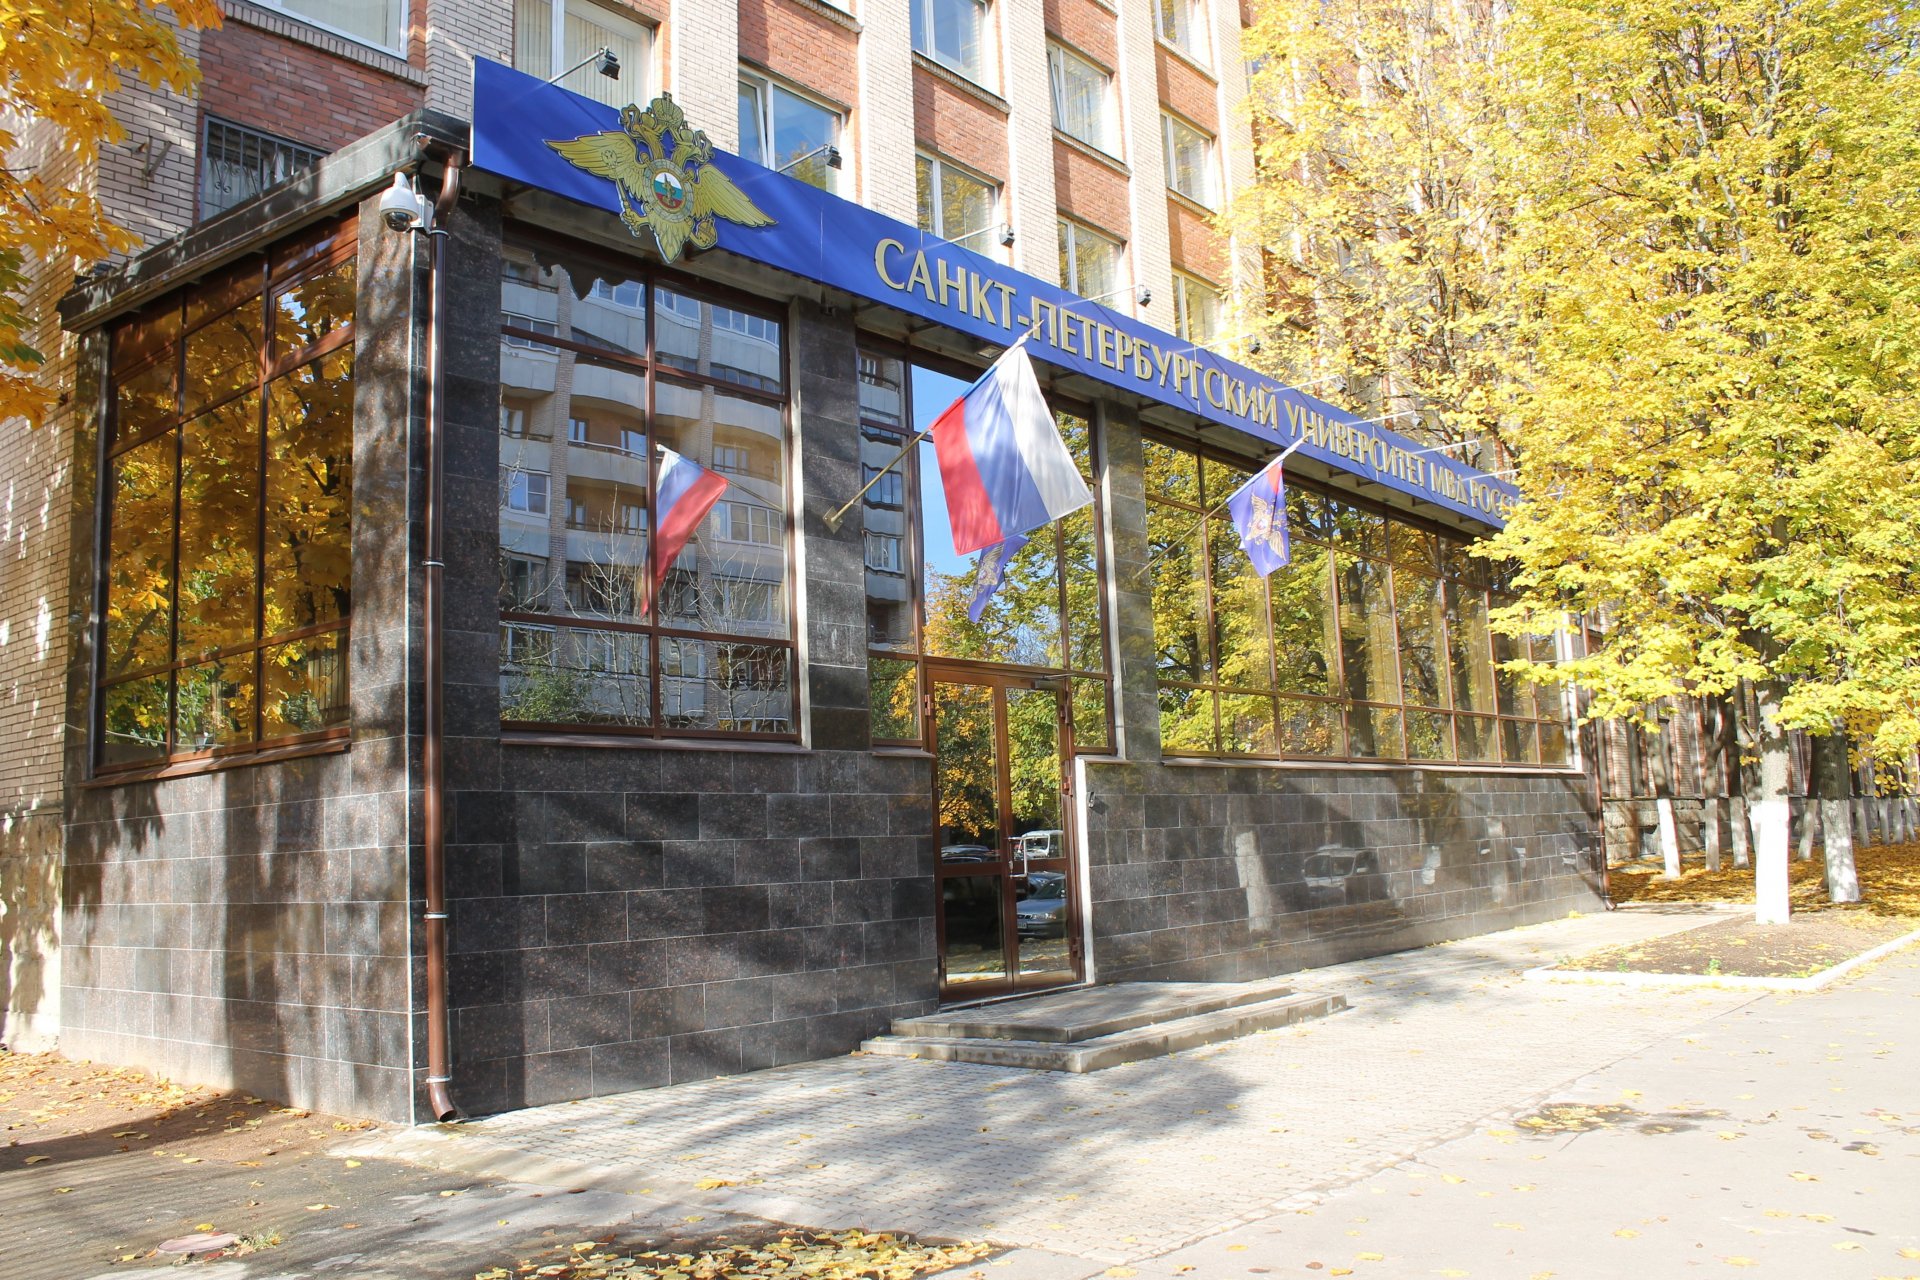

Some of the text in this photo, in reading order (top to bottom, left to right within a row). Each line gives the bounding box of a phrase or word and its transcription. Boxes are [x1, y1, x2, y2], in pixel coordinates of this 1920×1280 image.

[874, 238, 1278, 431] САНКТ-ПЕТЕРБУРГСКИЙ
[1283, 399, 1425, 488] УНИВЕРСИТЕТ
[1430, 462, 1468, 505] МВД
